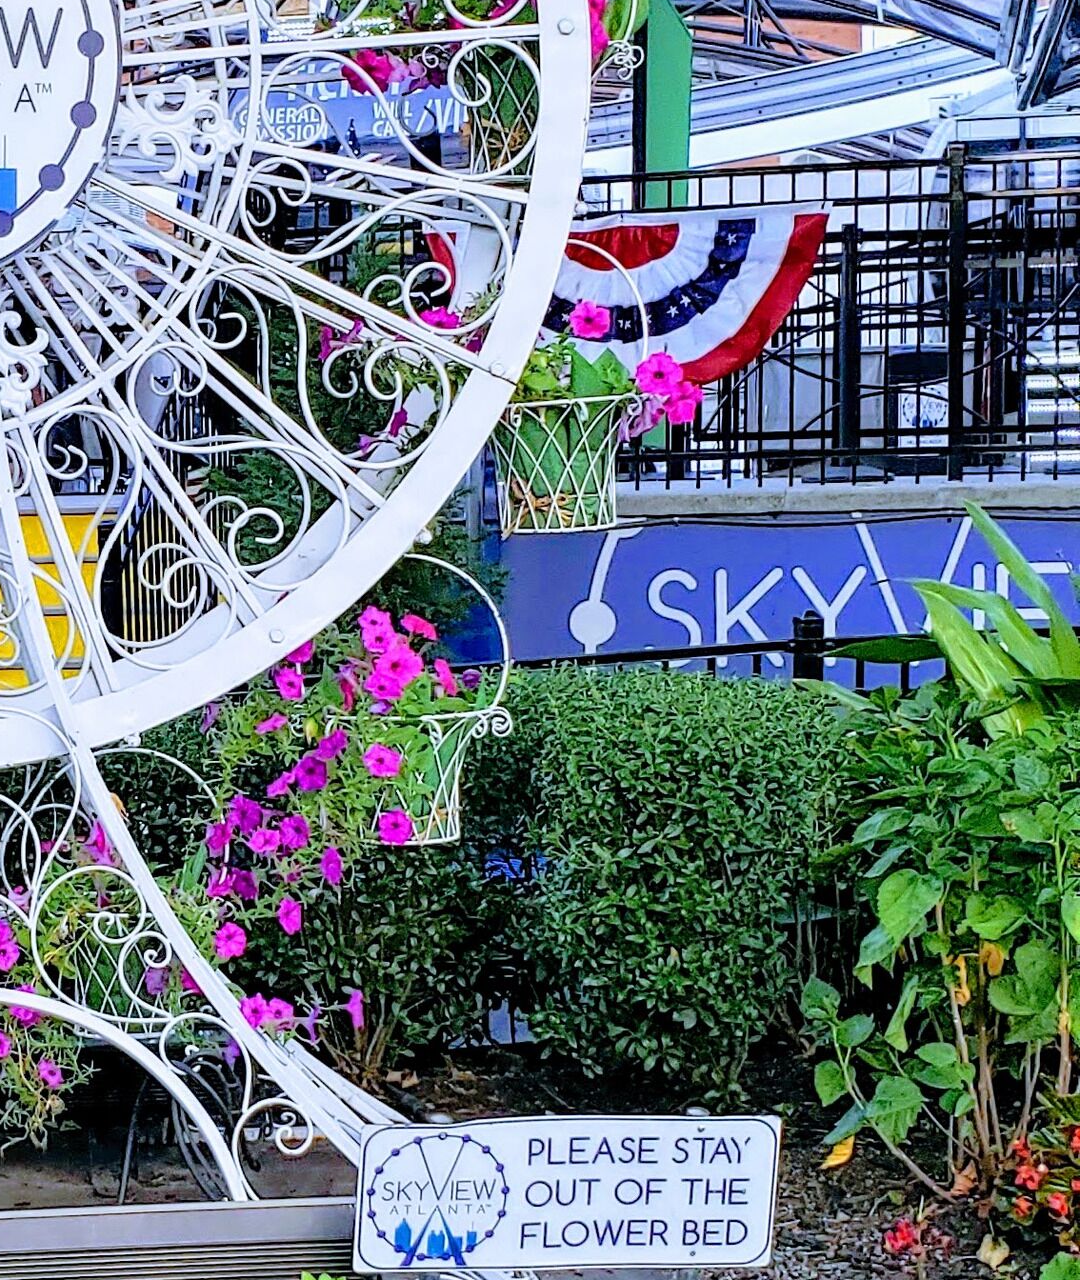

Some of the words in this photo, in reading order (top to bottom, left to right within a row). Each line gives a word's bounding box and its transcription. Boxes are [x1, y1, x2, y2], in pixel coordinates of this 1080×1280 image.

[527, 1136, 660, 1166] PLEASE
[672, 1136, 751, 1164] STAY
[525, 1178, 601, 1207] OUT
[614, 1178, 668, 1206] OF
[681, 1178, 751, 1206] THE
[520, 1219, 669, 1249] FLOWER
[681, 1219, 749, 1247] BED
